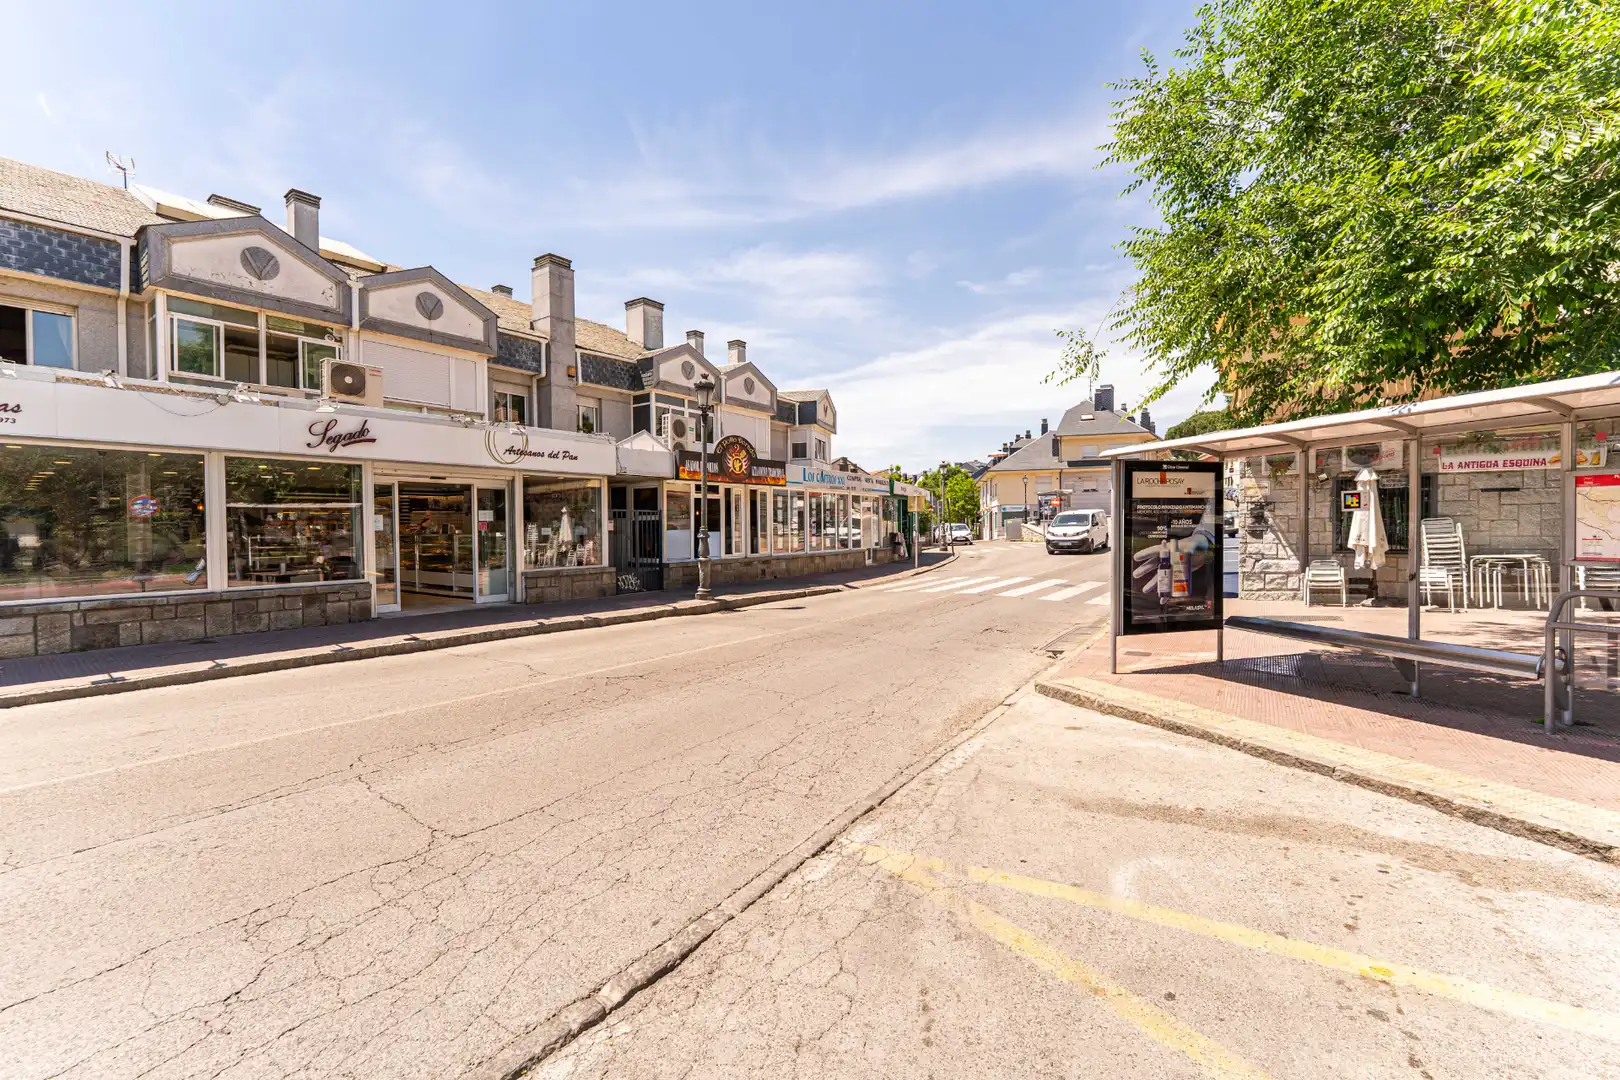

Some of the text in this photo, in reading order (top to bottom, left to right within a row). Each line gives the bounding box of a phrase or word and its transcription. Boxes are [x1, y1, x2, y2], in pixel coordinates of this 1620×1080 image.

[306, 418, 373, 453] Segado
[503, 445, 578, 460] Artesanos del Pan
[1457, 460, 1499, 469] ANTIGUA
[1503, 458, 1547, 468] ESQUINA
